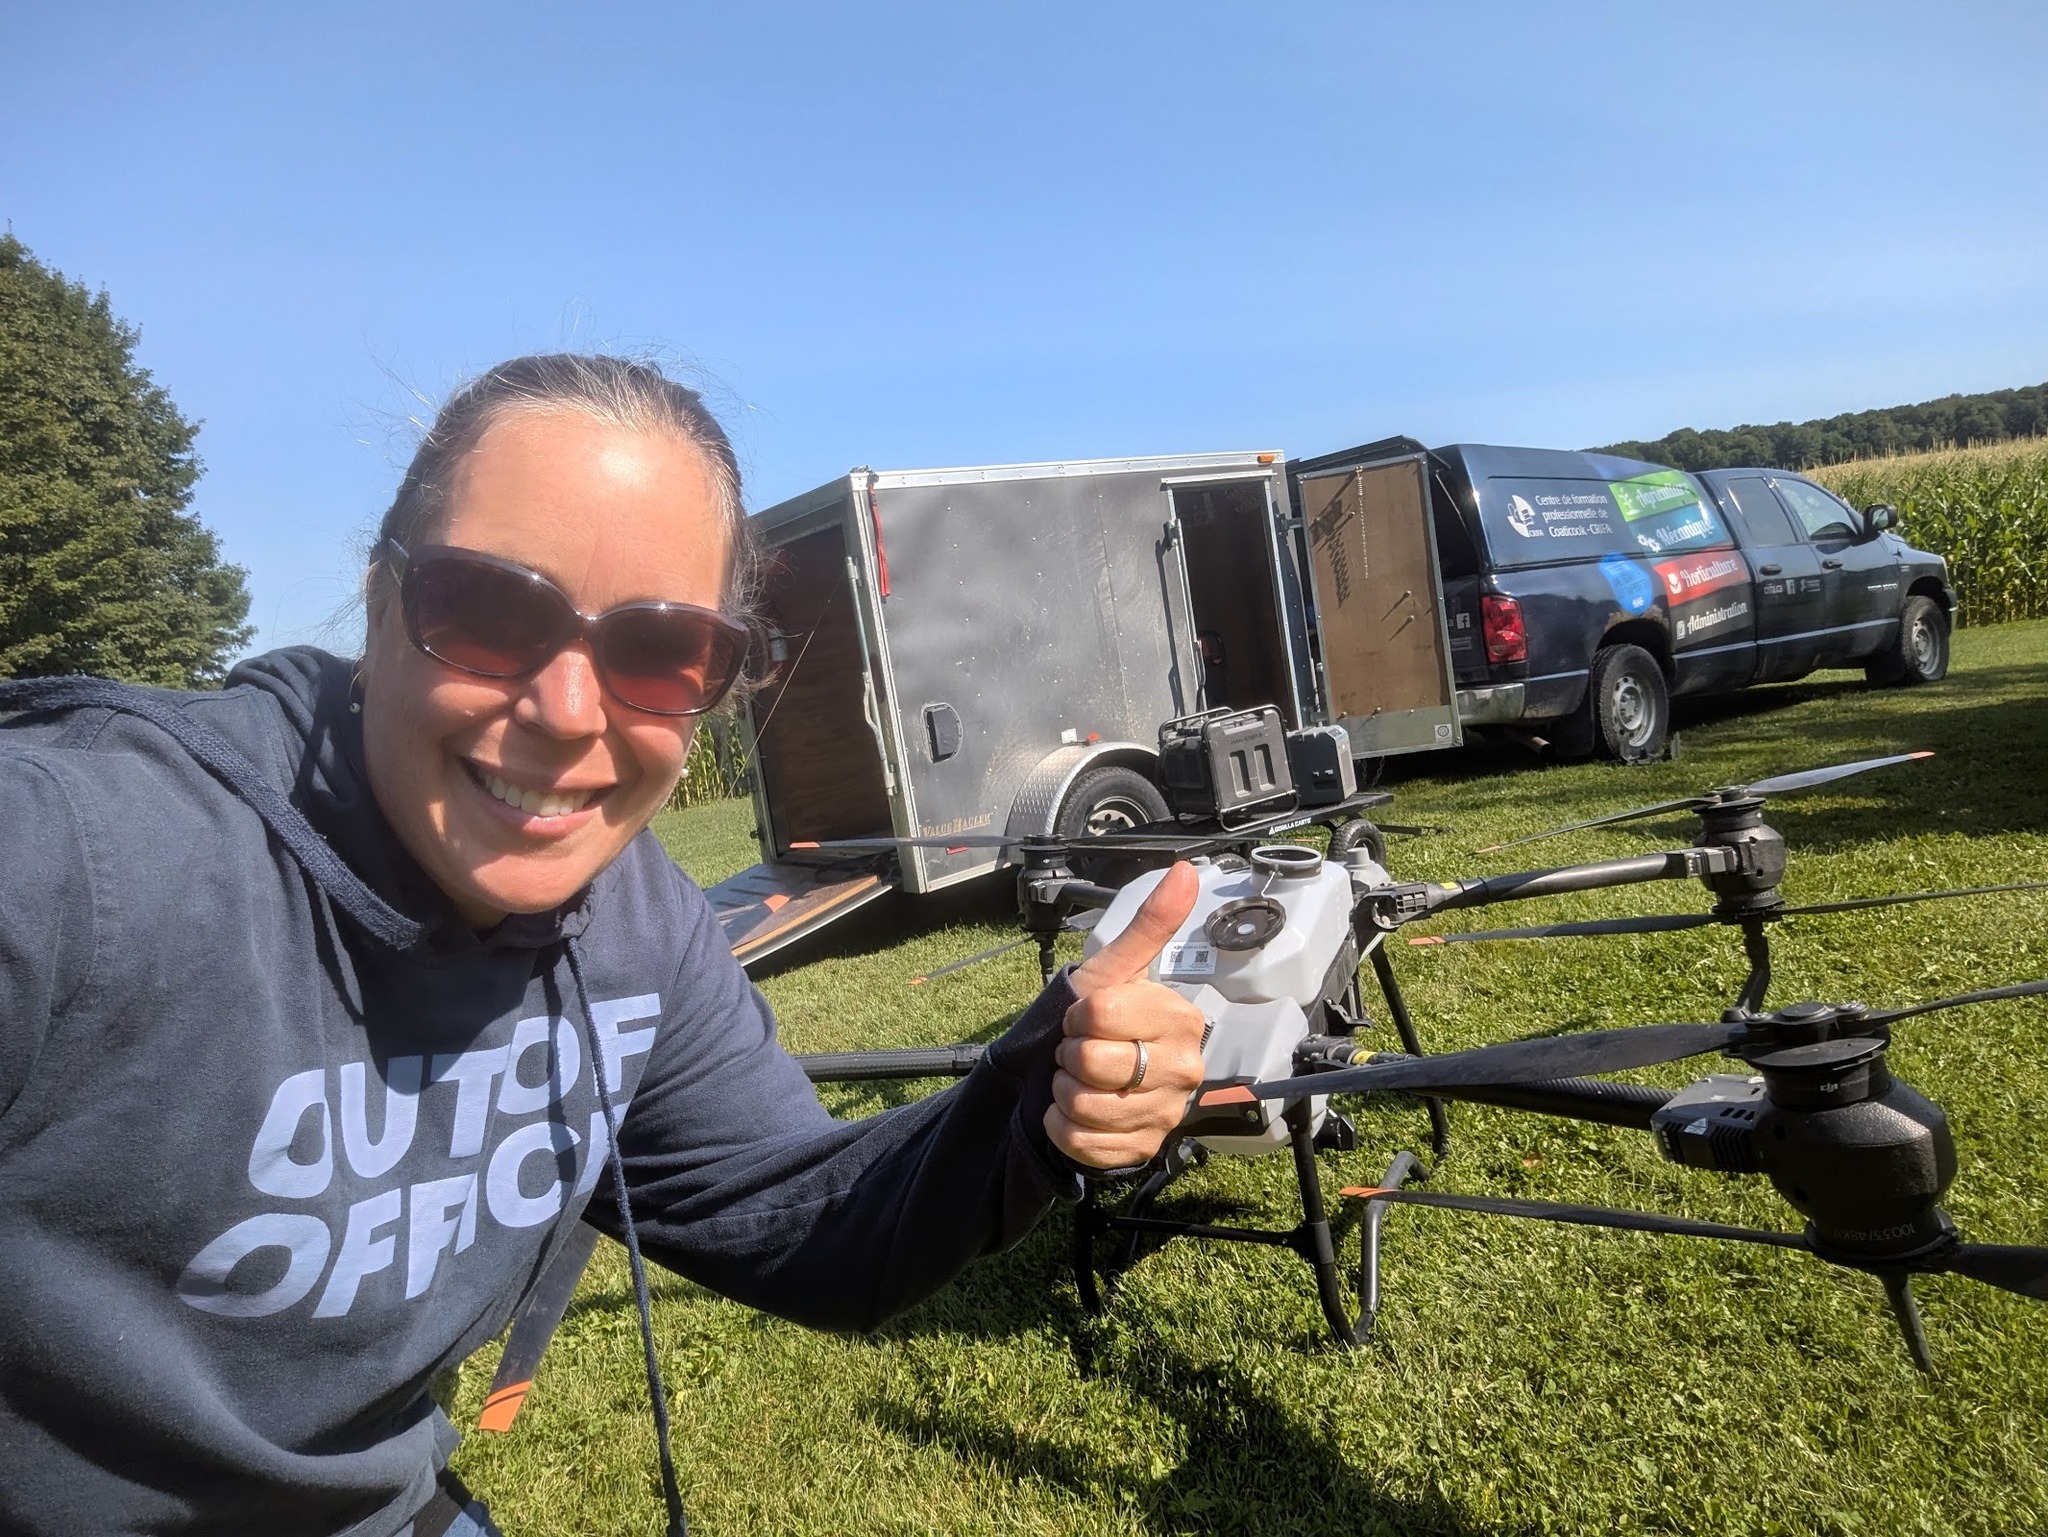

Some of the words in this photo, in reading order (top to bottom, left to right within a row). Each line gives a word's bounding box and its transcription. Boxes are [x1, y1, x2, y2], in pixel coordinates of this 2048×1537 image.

[1535, 495, 1561, 506] Centre
[1561, 494, 1572, 505] de
[1571, 494, 1608, 504] formation
[1636, 483, 1691, 509] Agriculture
[1542, 509, 1597, 523] professionnelle
[1598, 508, 1608, 519] de
[1529, 529, 1544, 537] CRIFA
[1548, 525, 1587, 538] Coaticook
[1589, 524, 1613, 535] CRIFA
[1655, 519, 1714, 546] Mécanique
[1680, 559, 1739, 588] Horticulture
[1686, 601, 1748, 635] Administration
